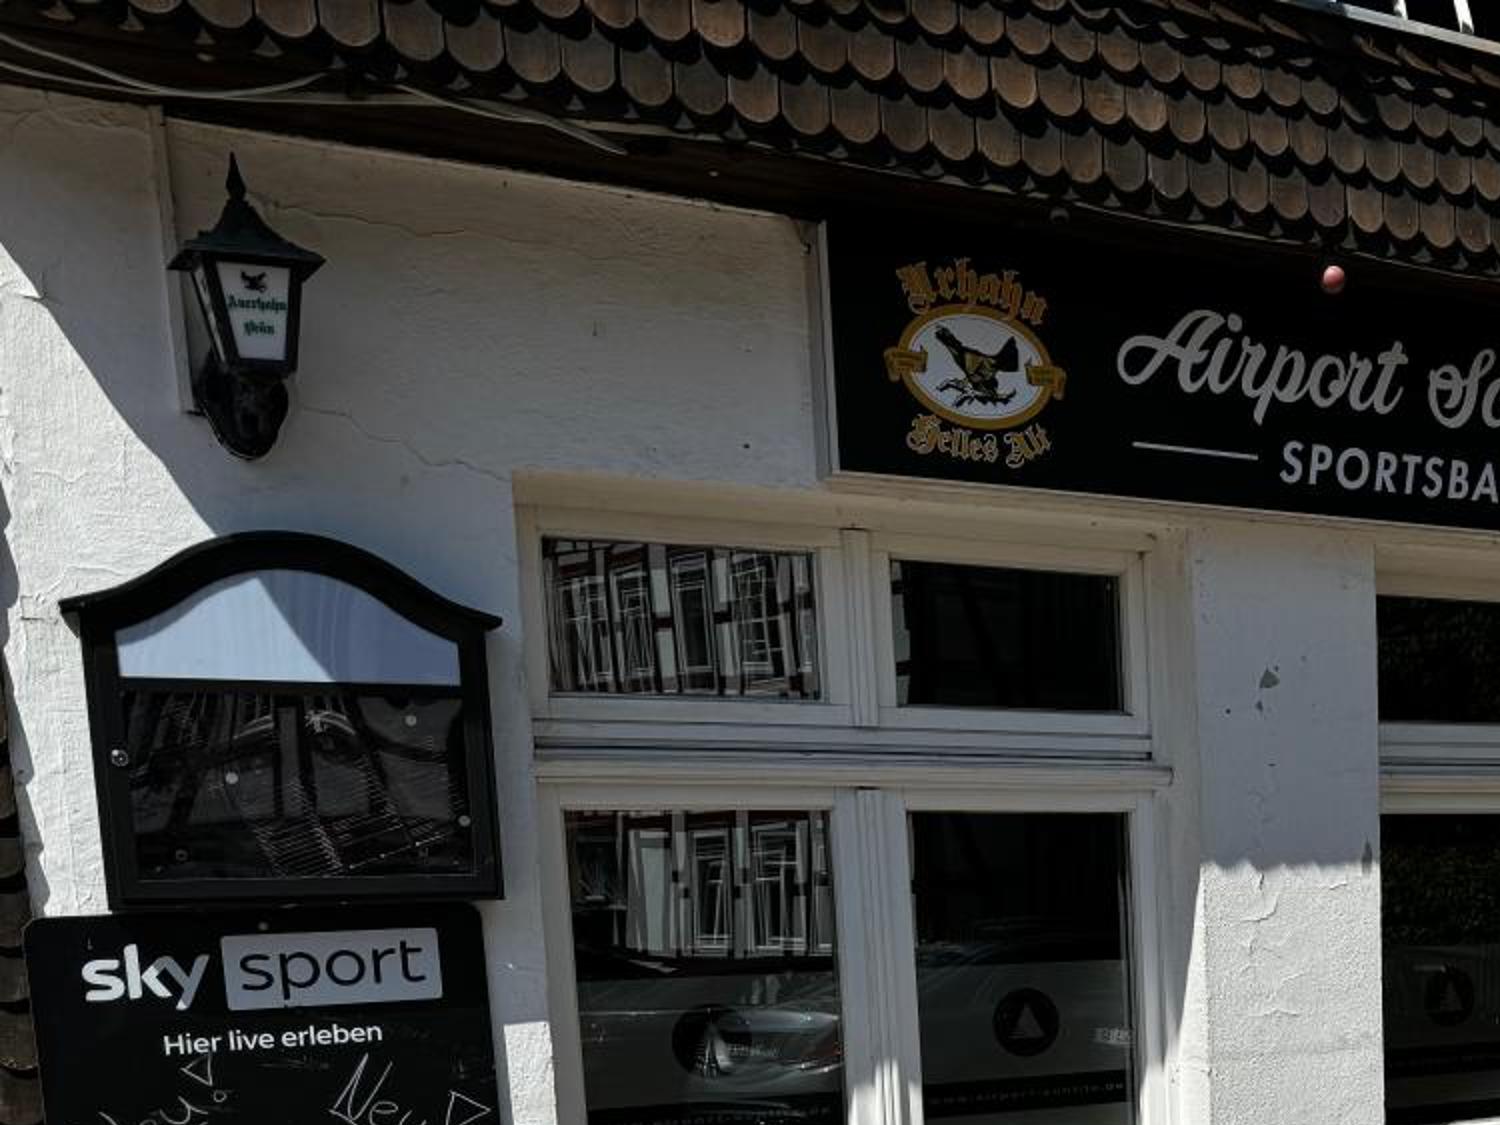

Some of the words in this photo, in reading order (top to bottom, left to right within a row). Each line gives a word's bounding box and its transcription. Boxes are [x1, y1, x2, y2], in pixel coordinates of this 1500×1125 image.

[1117, 308, 1409, 426] Airport
[81, 943, 210, 1011] sky
[240, 940, 426, 999] sport
[164, 1034, 222, 1056] Hier
[229, 1030, 274, 1051] live
[281, 1023, 382, 1047] erleben
